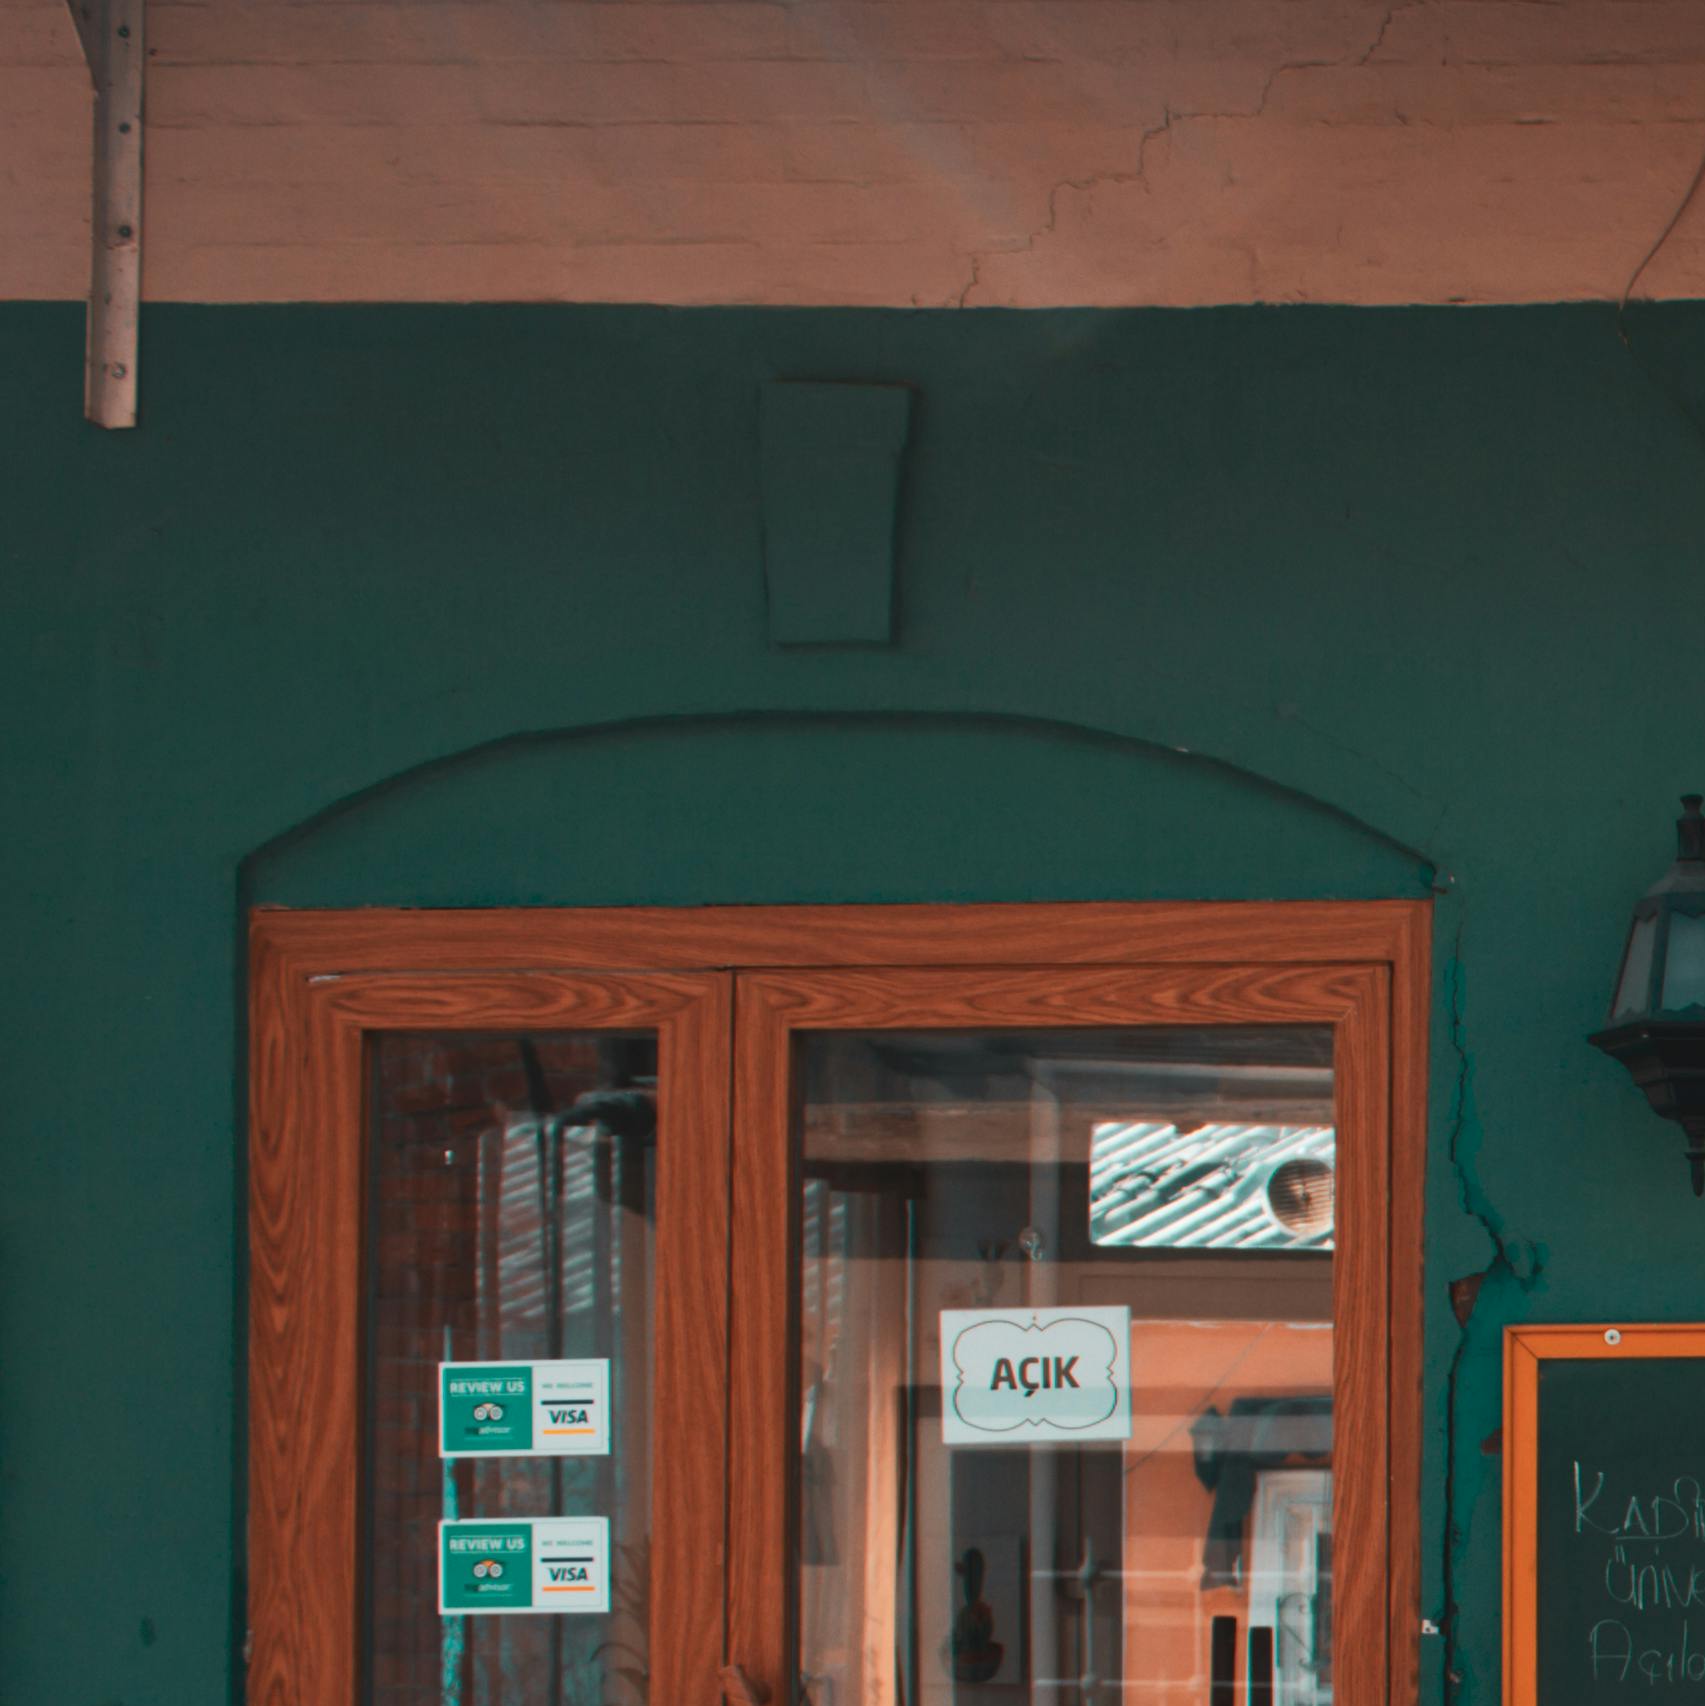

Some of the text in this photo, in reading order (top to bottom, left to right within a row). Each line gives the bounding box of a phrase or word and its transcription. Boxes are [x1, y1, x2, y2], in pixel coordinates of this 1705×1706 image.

[989, 1355, 1080, 1398] AÇIK
[450, 1381, 503, 1395] REVIEW
[506, 1380, 525, 1394] US
[549, 1409, 589, 1424] VISA
[450, 1538, 503, 1552] REVIEW
[506, 1537, 525, 1551] US
[549, 1566, 589, 1581] VISA
